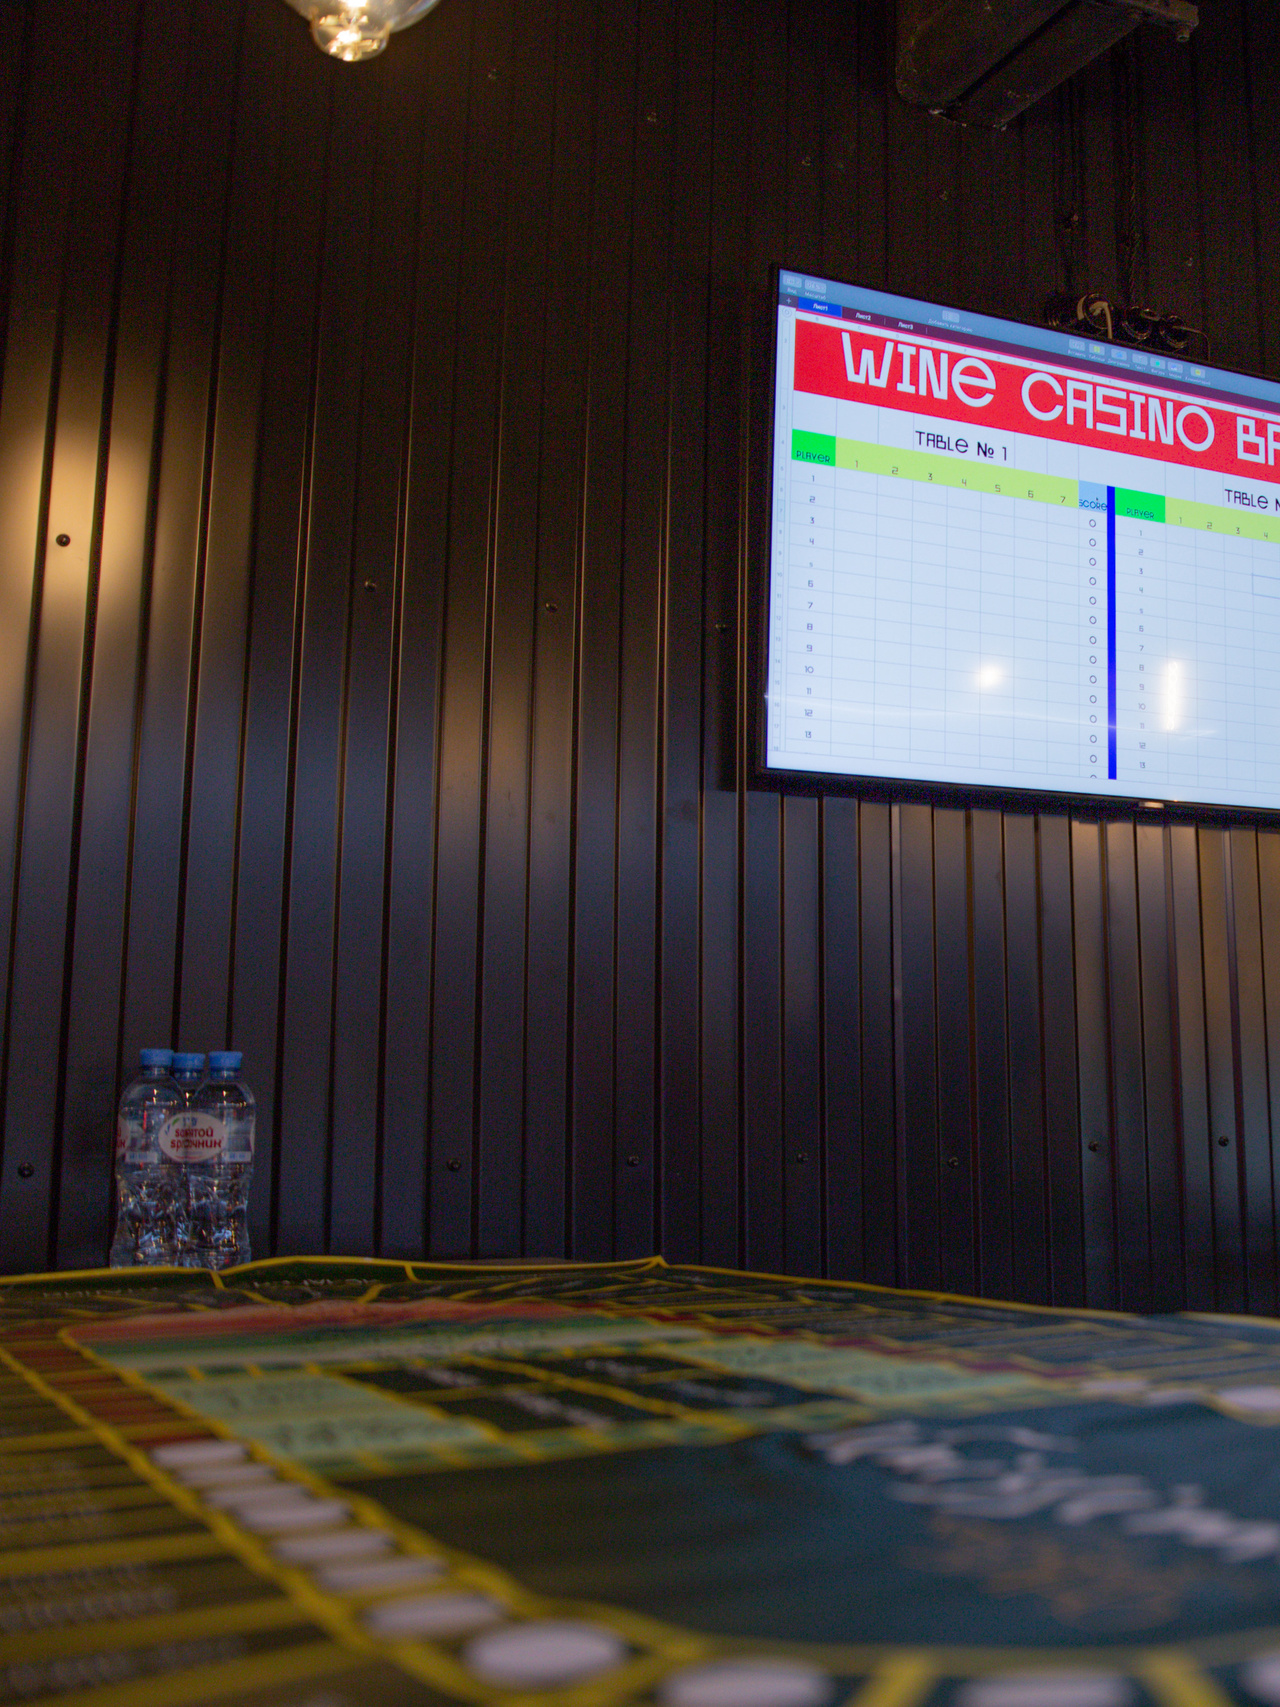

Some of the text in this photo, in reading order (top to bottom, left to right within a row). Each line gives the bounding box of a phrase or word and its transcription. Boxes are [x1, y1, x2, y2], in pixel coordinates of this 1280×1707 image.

[813, 303, 829, 312] Лист1
[855, 312, 872, 321] Лист2
[898, 321, 914, 330] Лист3
[1021, 372, 1215, 453] CASINO
[1002, 446, 1007, 461] 1
[892, 467, 898, 475] 2
[927, 473, 933, 481] 3
[961, 479, 967, 487] 4
[994, 484, 1000, 492] 5
[1028, 490, 1034, 498] 6
[1060, 496, 1066, 504] 7
[810, 496, 816, 504] 2
[809, 517, 815, 525] 3
[1206, 522, 1212, 530] 2
[1235, 527, 1241, 535] 3
[809, 537, 815, 545] 4
[808, 580, 814, 588] 6
[808, 601, 814, 609] 7
[807, 623, 813, 631] 8
[806, 645, 812, 653] 9
[805, 666, 814, 674] 10
[806, 687, 812, 695] 11
[804, 709, 812, 717] 12
[804, 731, 812, 739] 13
